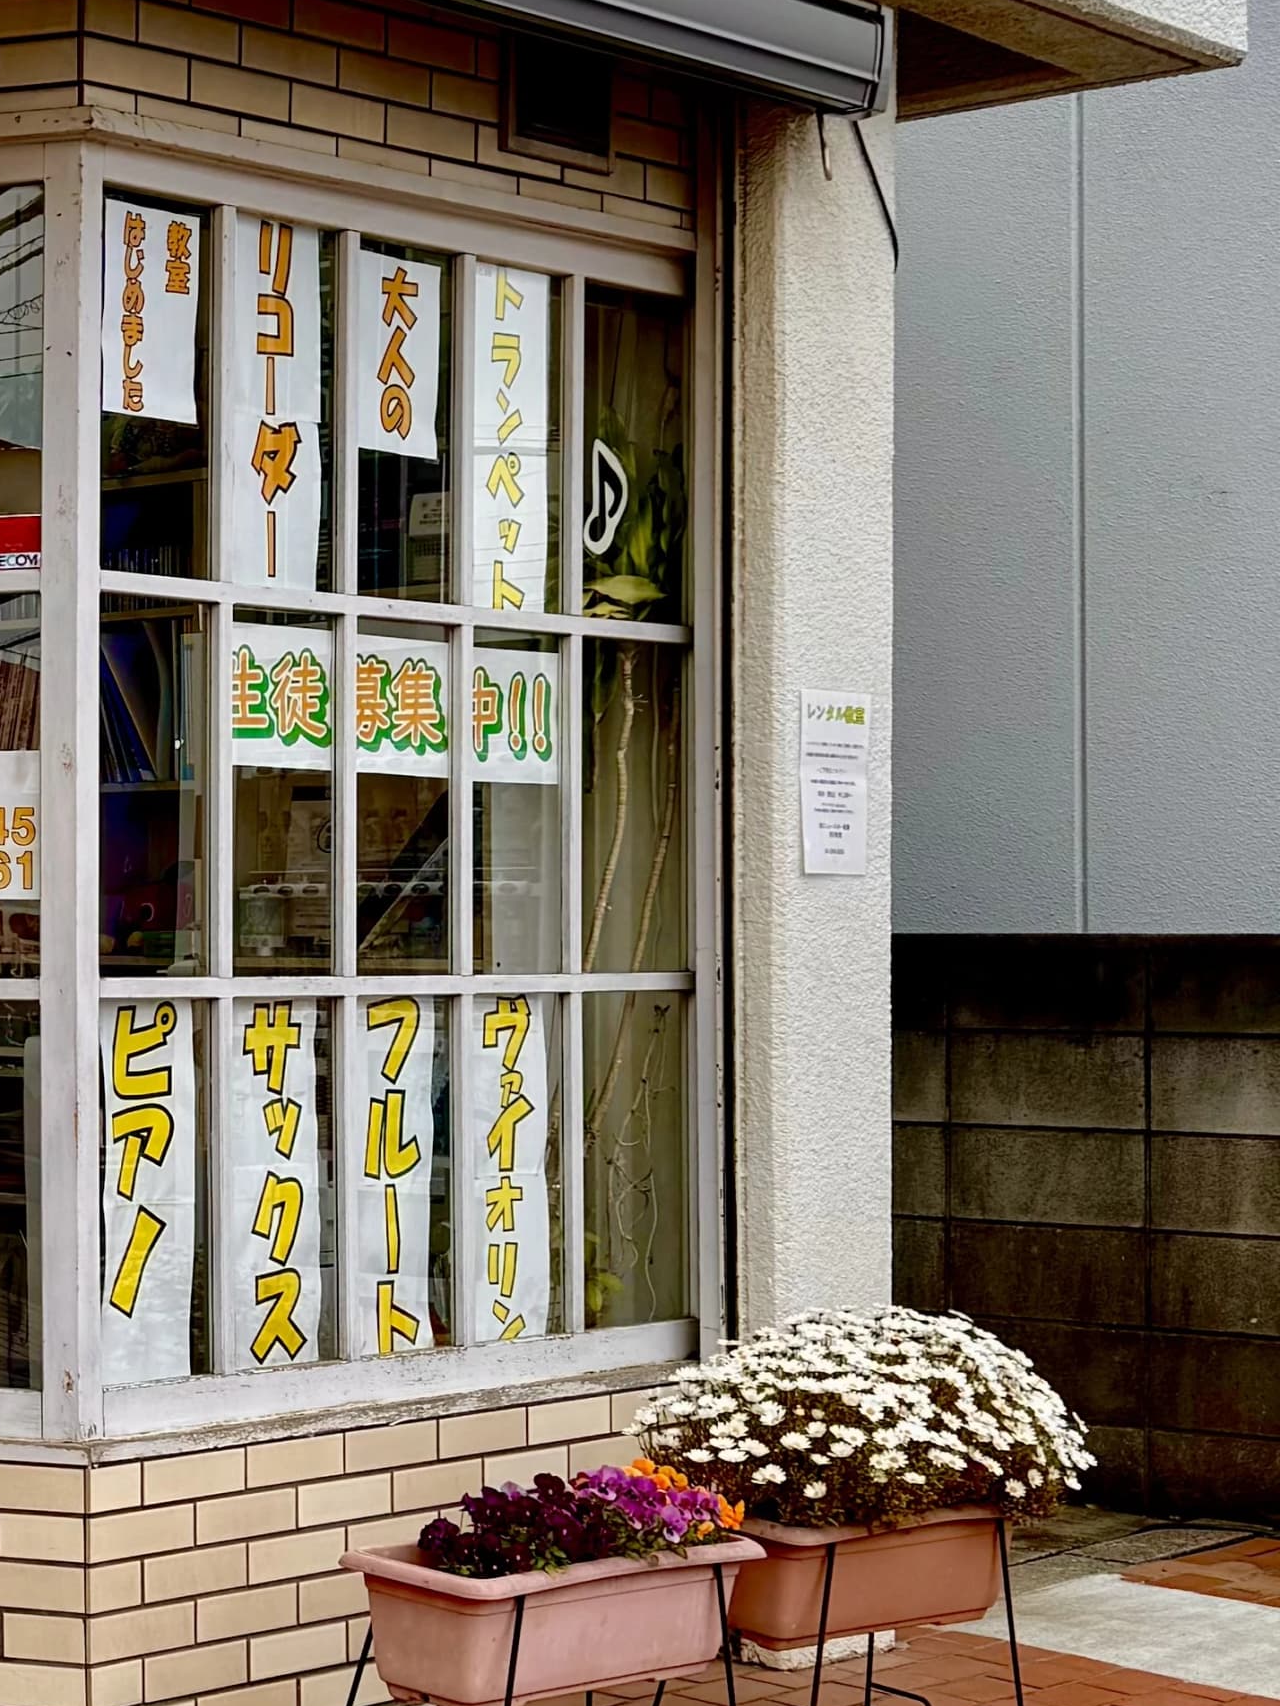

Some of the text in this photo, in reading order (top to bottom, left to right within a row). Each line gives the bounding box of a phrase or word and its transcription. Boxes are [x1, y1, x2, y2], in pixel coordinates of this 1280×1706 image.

[121, 210, 147, 414] はじめました
[164, 219, 193, 296] 教室
[250, 219, 305, 579] リコーダー
[376, 265, 420, 442] 大人の
[484, 265, 527, 612] トランペット
[109, 999, 178, 1319] ピアノ
[241, 998, 308, 1366] サックス
[363, 994, 422, 1355] フルート
[481, 994, 536, 1344] ヴァイオリン
